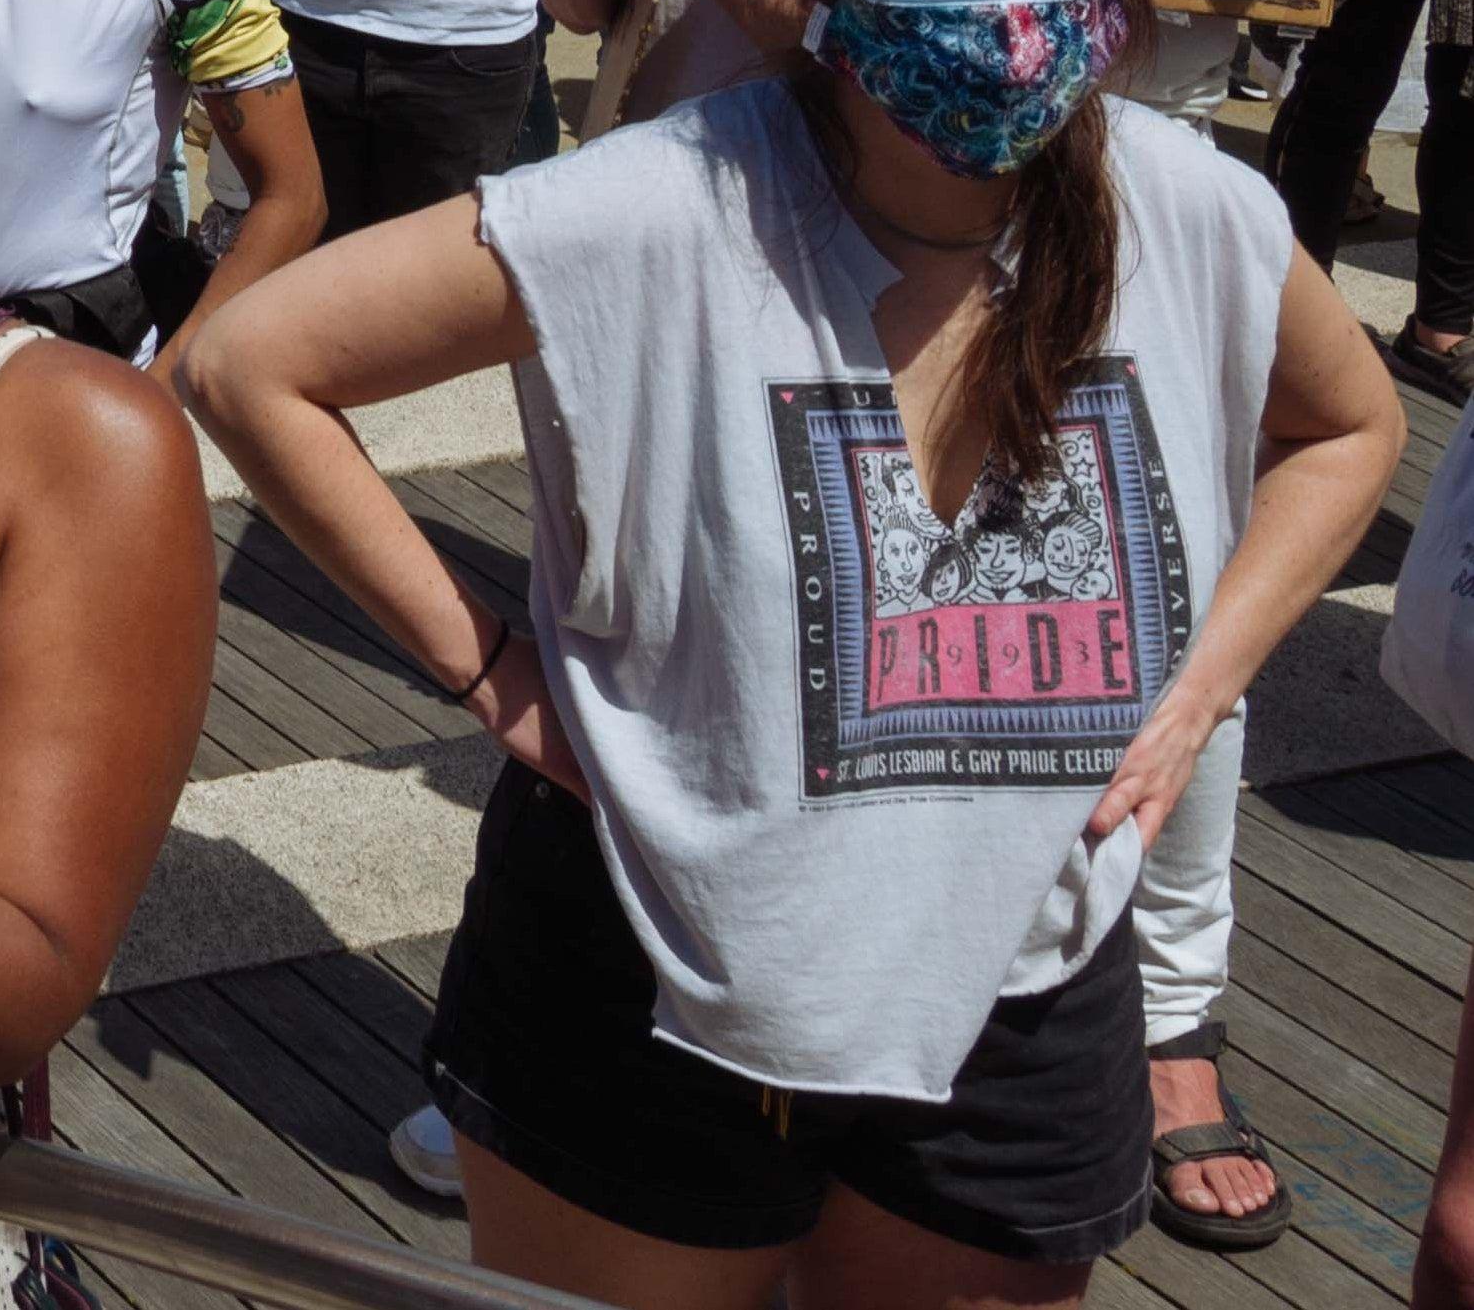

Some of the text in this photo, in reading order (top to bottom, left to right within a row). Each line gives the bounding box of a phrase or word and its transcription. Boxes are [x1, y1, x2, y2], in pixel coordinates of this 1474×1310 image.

[790, 487, 830, 699] PROUD
[877, 608, 1128, 703] PRIDE
[836, 761, 855, 783] ST.
[855, 753, 887, 781] LOUIS
[889, 749, 945, 777] LESBIAN
[952, 749, 964, 774] &
[969, 749, 1002, 775] GAY
[1008, 748, 1060, 775] PRIDE
